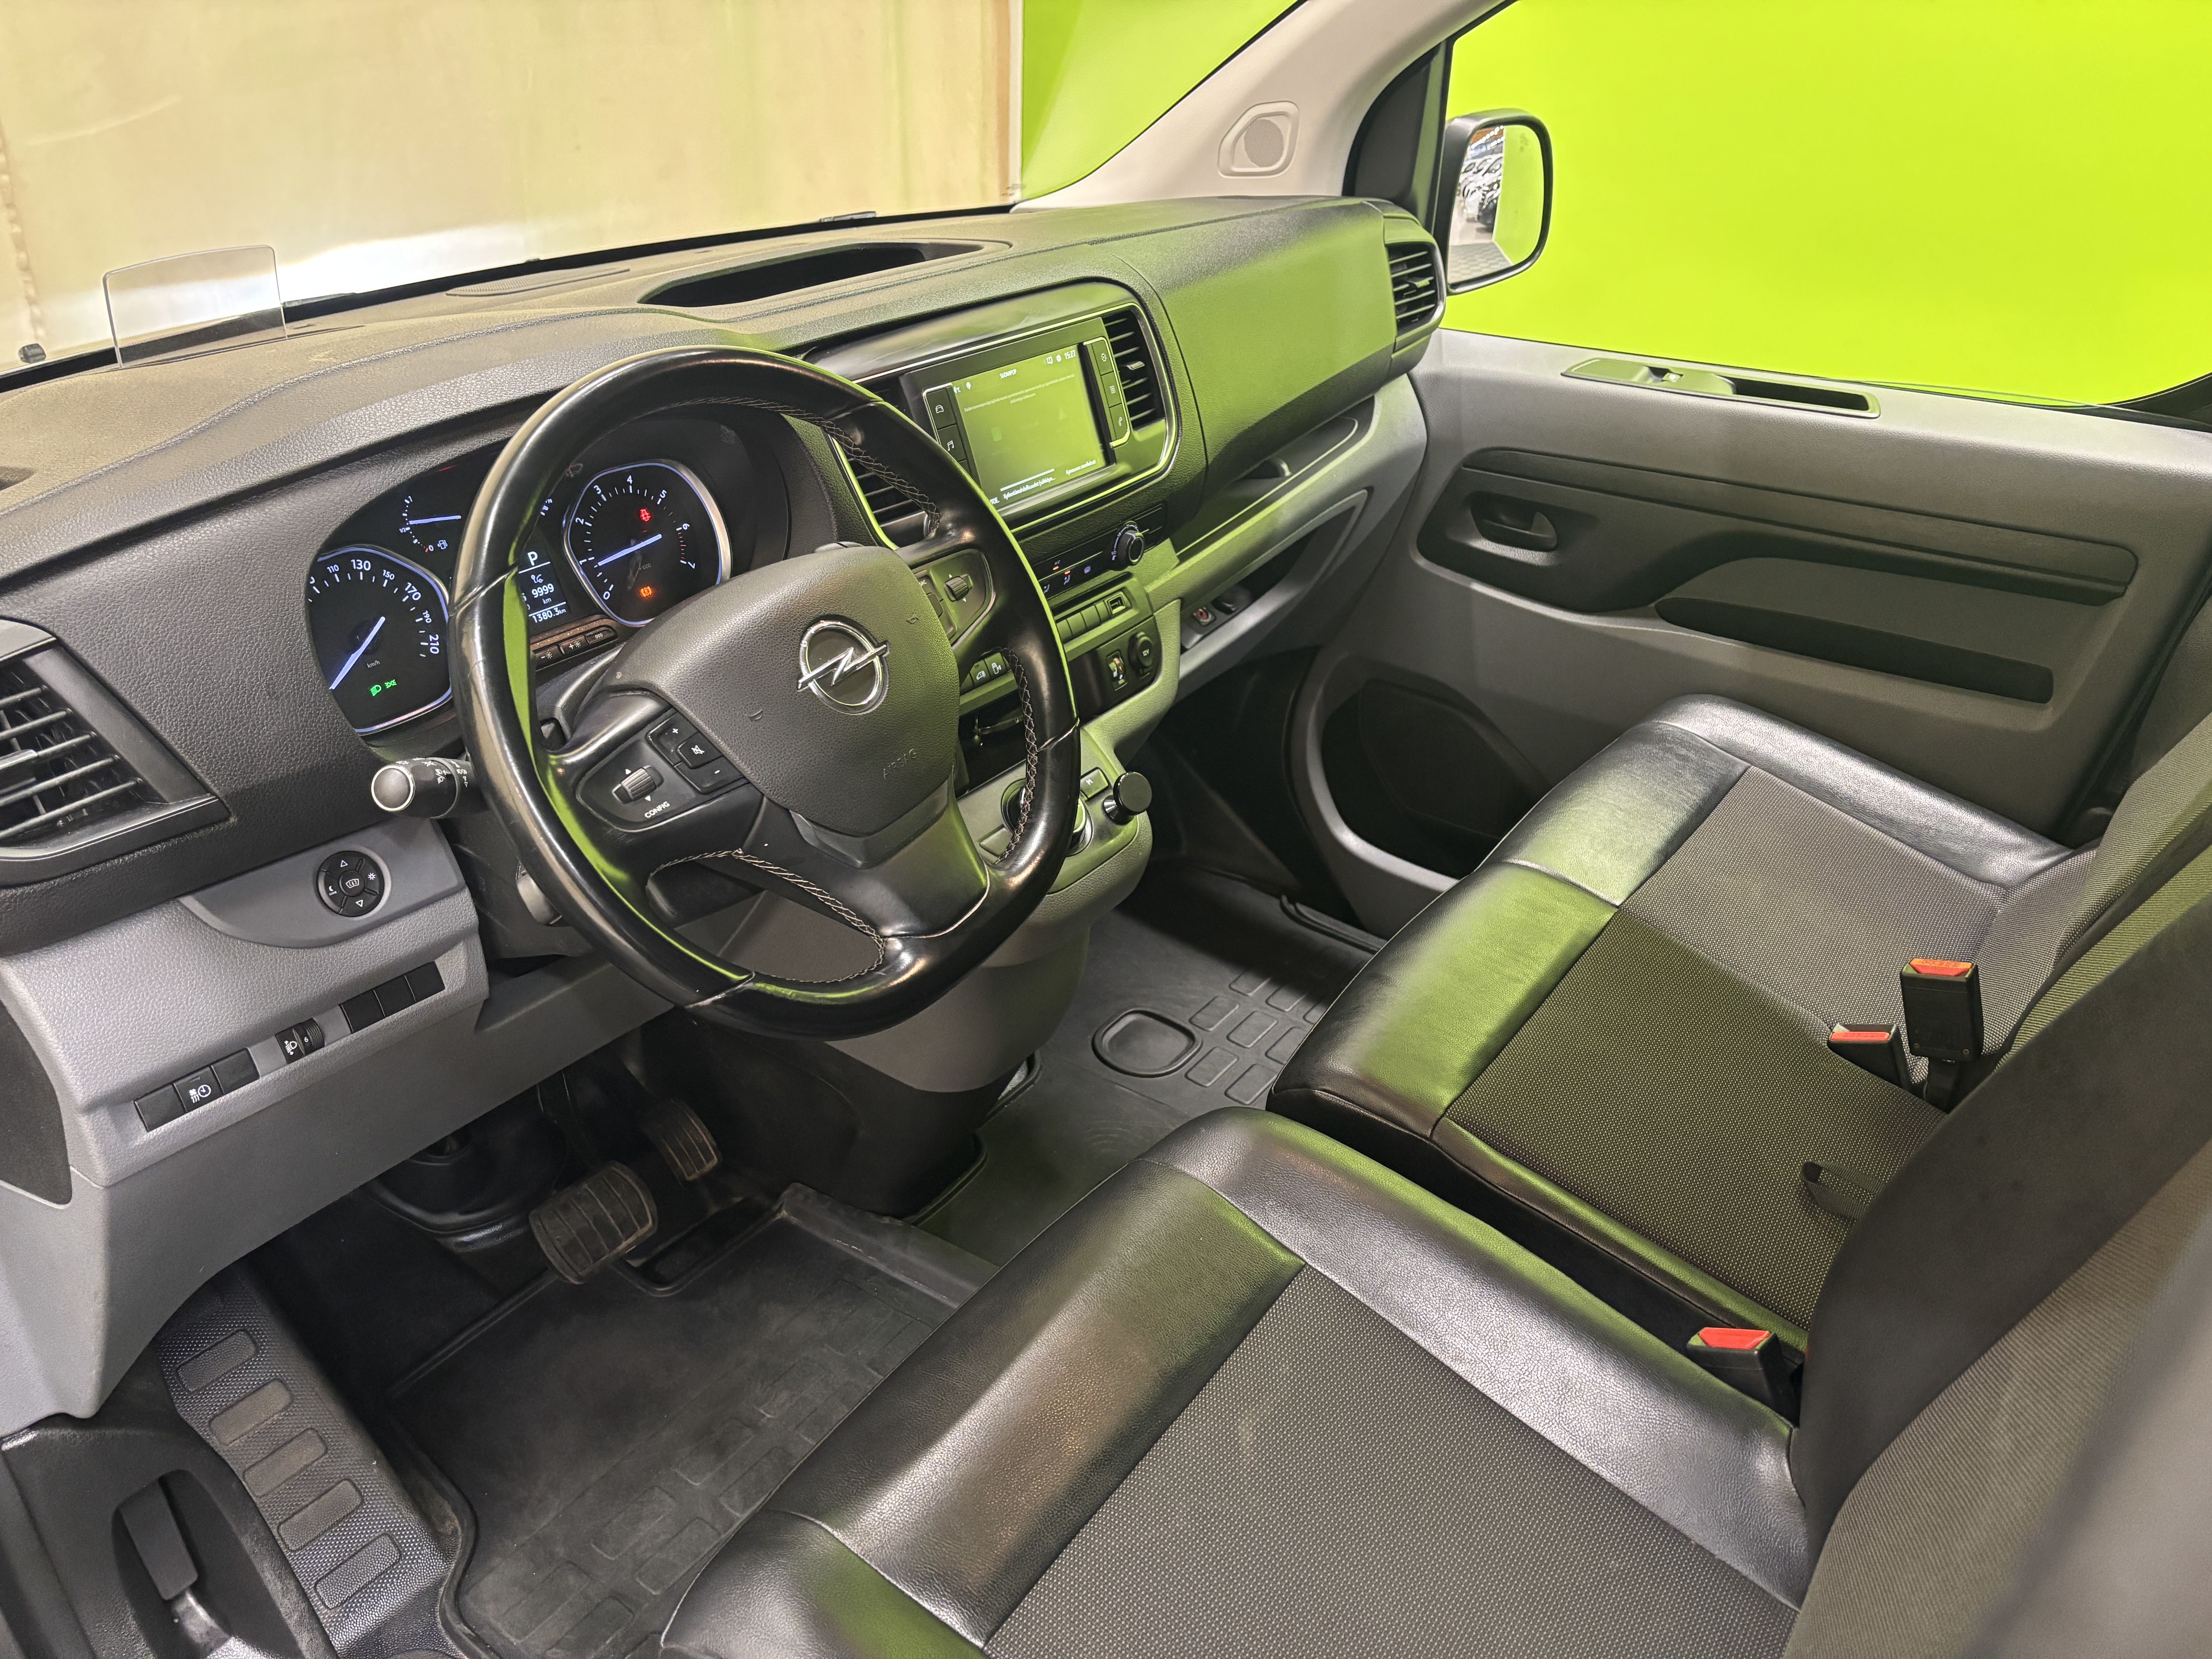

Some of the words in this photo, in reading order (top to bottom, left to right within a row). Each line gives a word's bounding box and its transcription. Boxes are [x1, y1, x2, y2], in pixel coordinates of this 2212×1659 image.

[627, 475, 633, 484] 4
[593, 485, 601, 494] 3
[659, 489, 667, 498] 5
[527, 551, 538, 566] P
[327, 565, 339, 573] 110
[351, 560, 371, 570] 130
[383, 570, 395, 580] 150
[405, 582, 421, 601] 170
[532, 583, 554, 598] 9999
[603, 591, 610, 600] 0
[422, 610, 431, 623] 190
[429, 634, 440, 654] 210
[367, 660, 380, 668] km/h
[883, 749, 917, 780] AIRBAG
[644, 801, 670, 818] CONFIG
